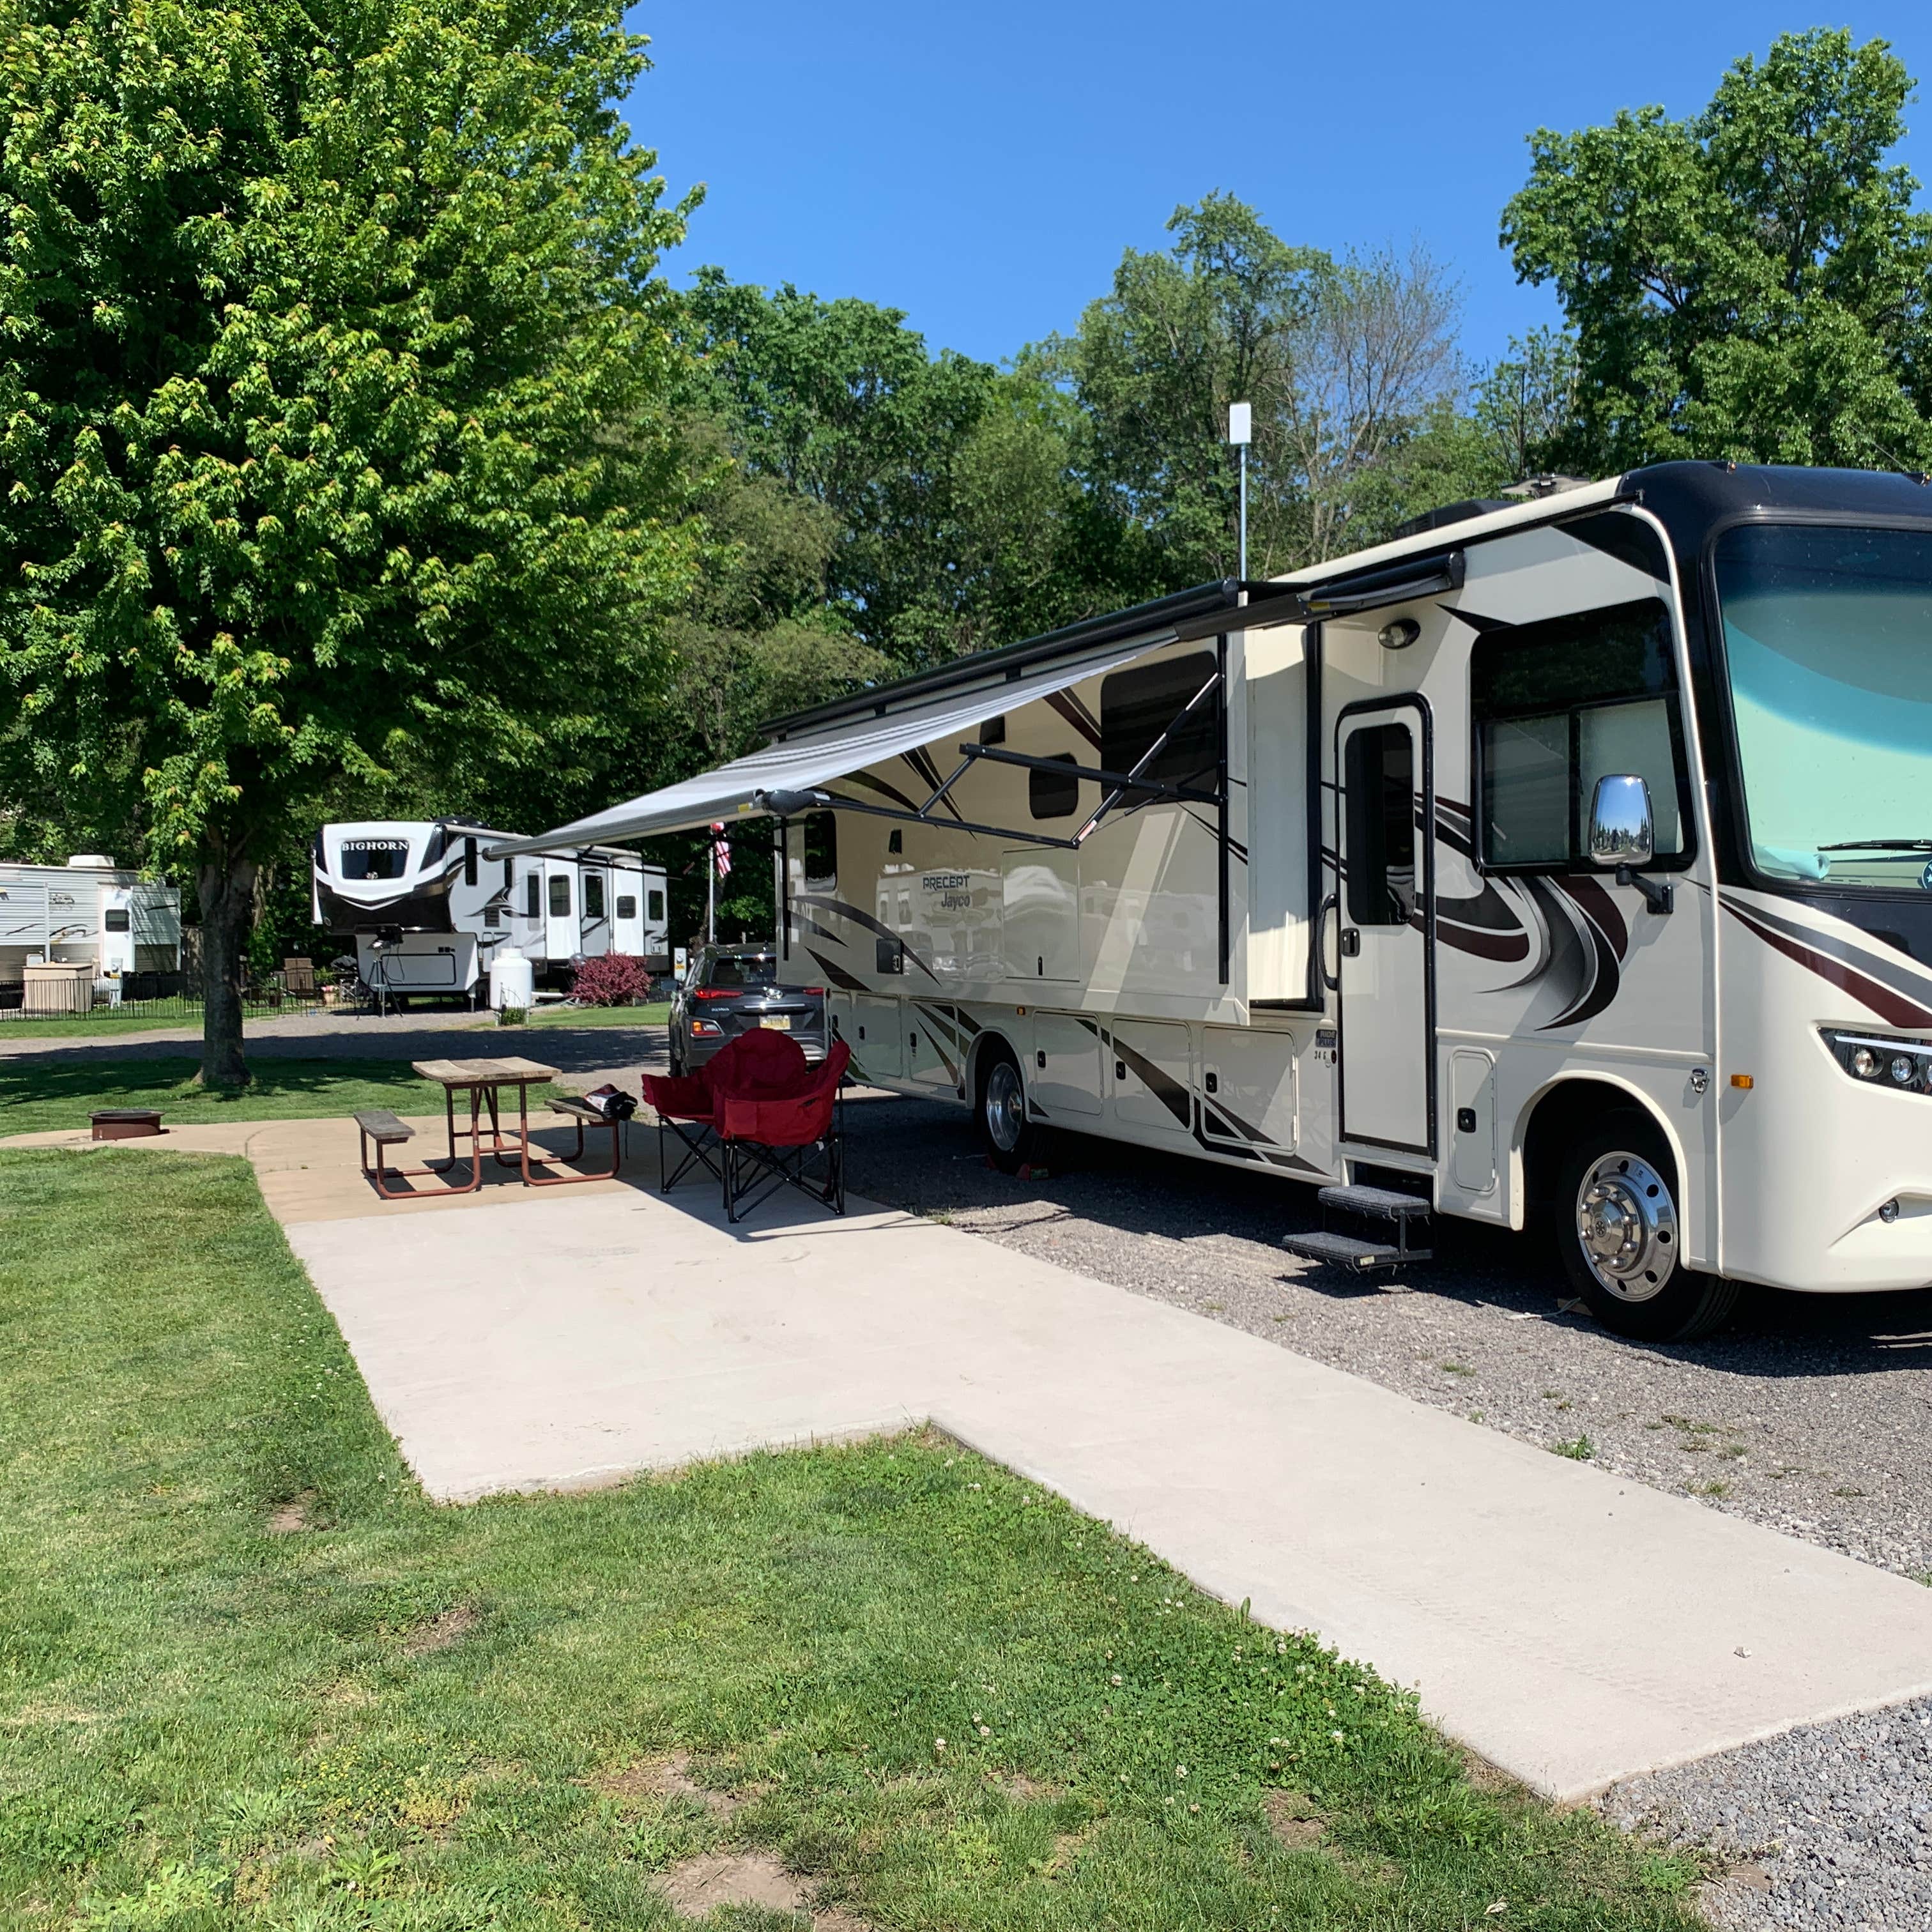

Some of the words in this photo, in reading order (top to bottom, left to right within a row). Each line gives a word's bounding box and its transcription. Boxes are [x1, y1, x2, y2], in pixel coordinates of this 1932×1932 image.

[342, 841, 408, 851] BIGHORN
[923, 875, 970, 891] PRECEPT
[941, 891, 970, 911] Jayco
